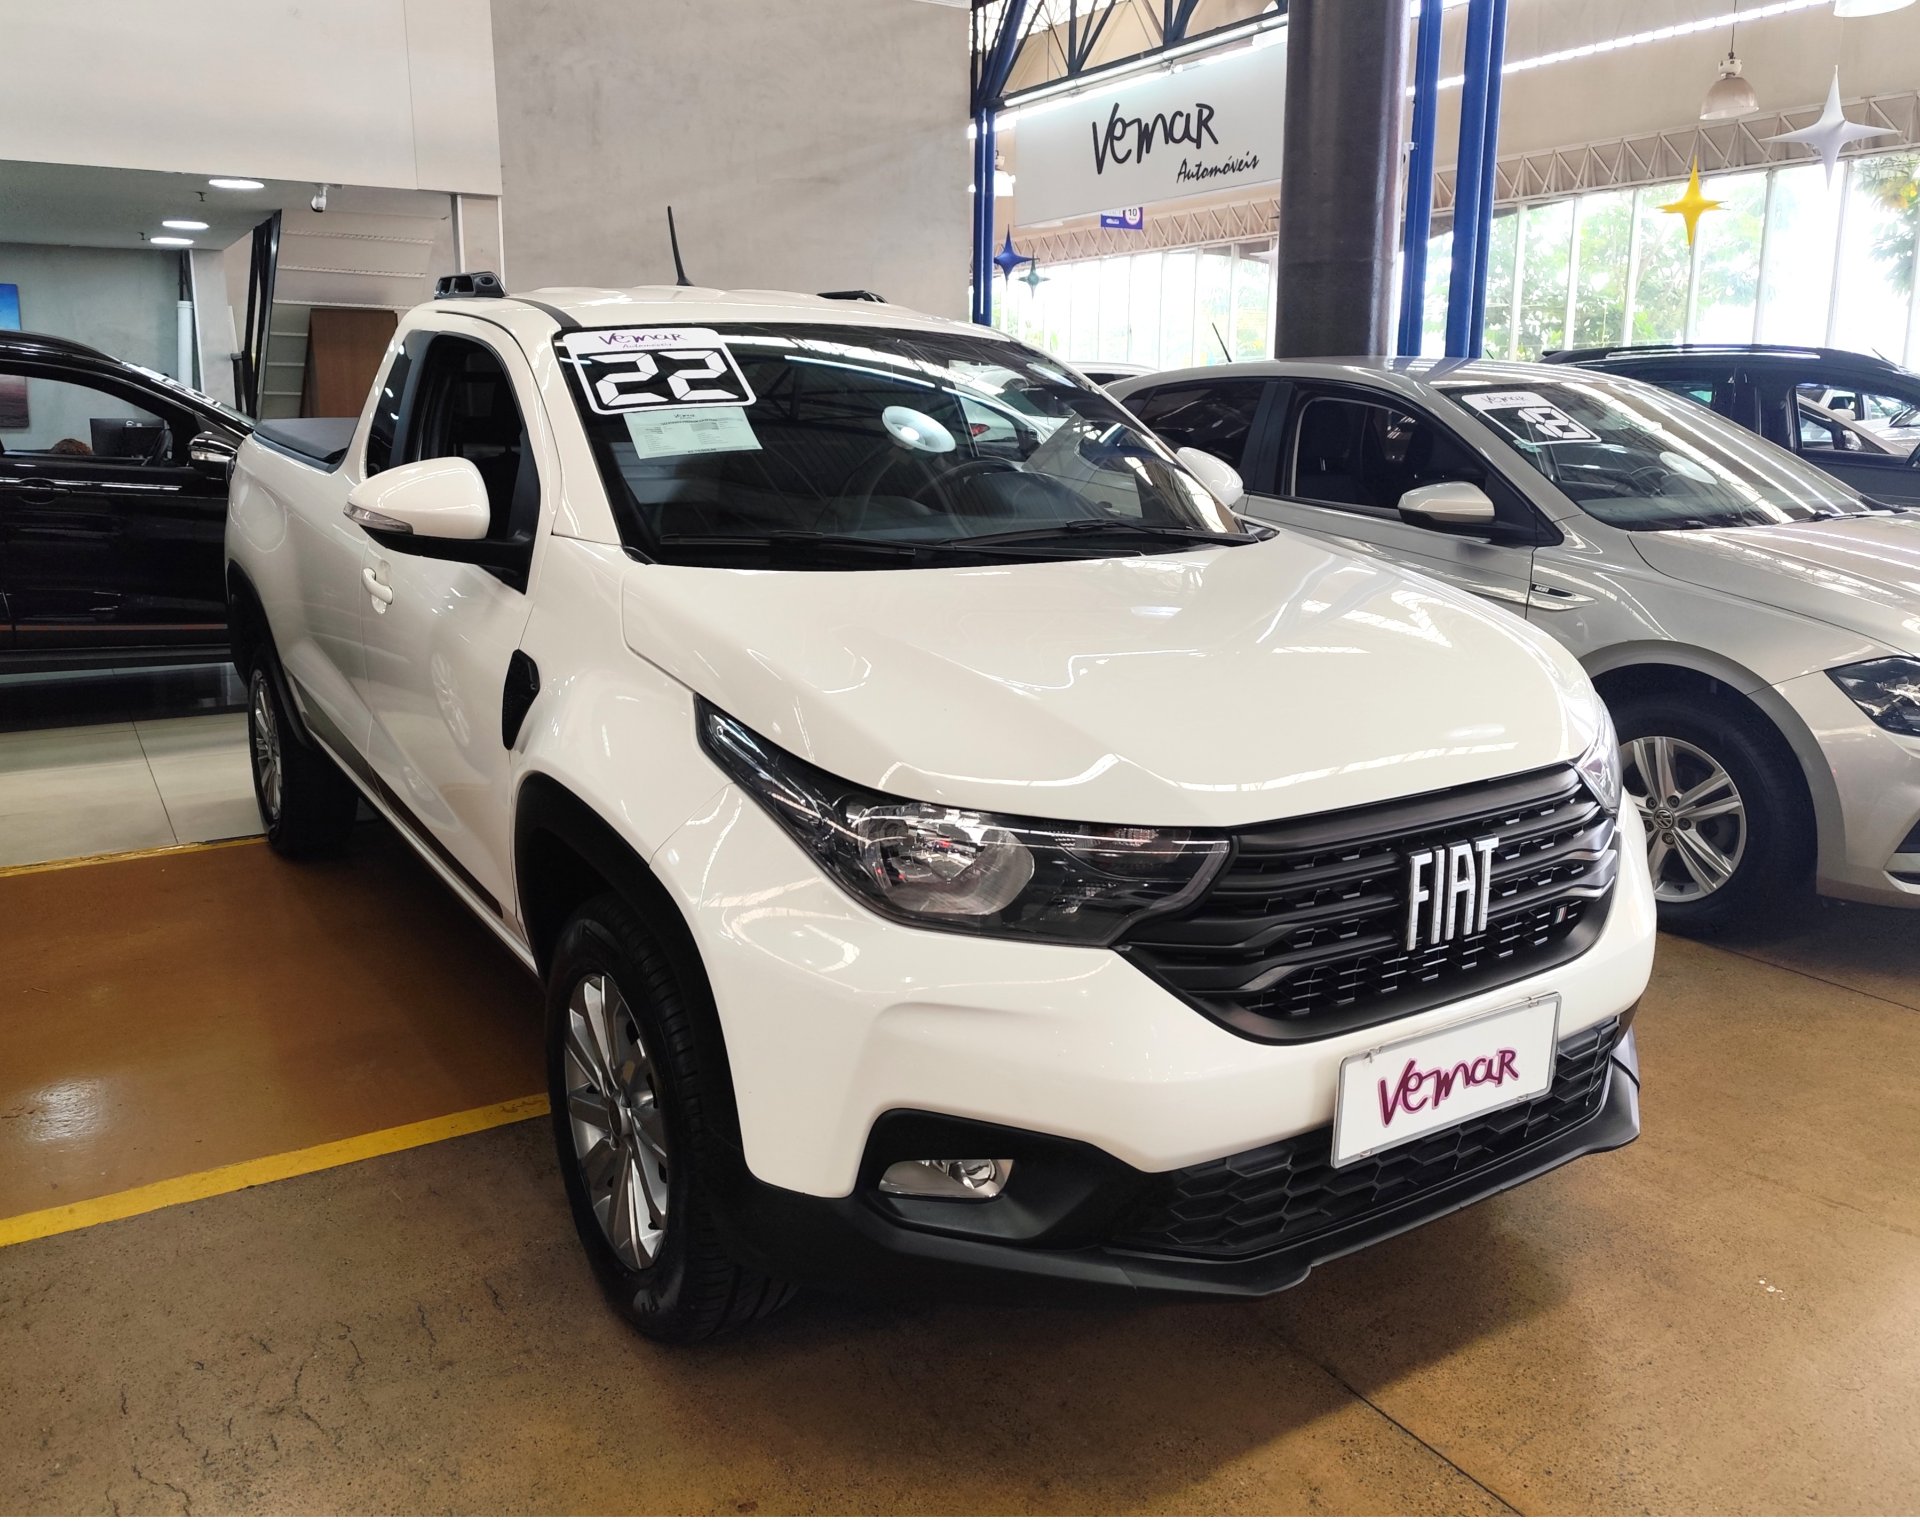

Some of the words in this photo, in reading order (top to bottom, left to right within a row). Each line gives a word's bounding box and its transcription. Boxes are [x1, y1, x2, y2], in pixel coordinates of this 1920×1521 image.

[1176, 151, 1260, 183] Automóveis
[1128, 208, 1138, 217] 10
[587, 351, 740, 407] 22
[1517, 407, 1592, 439] 18
[1406, 836, 1500, 951] FIAT
